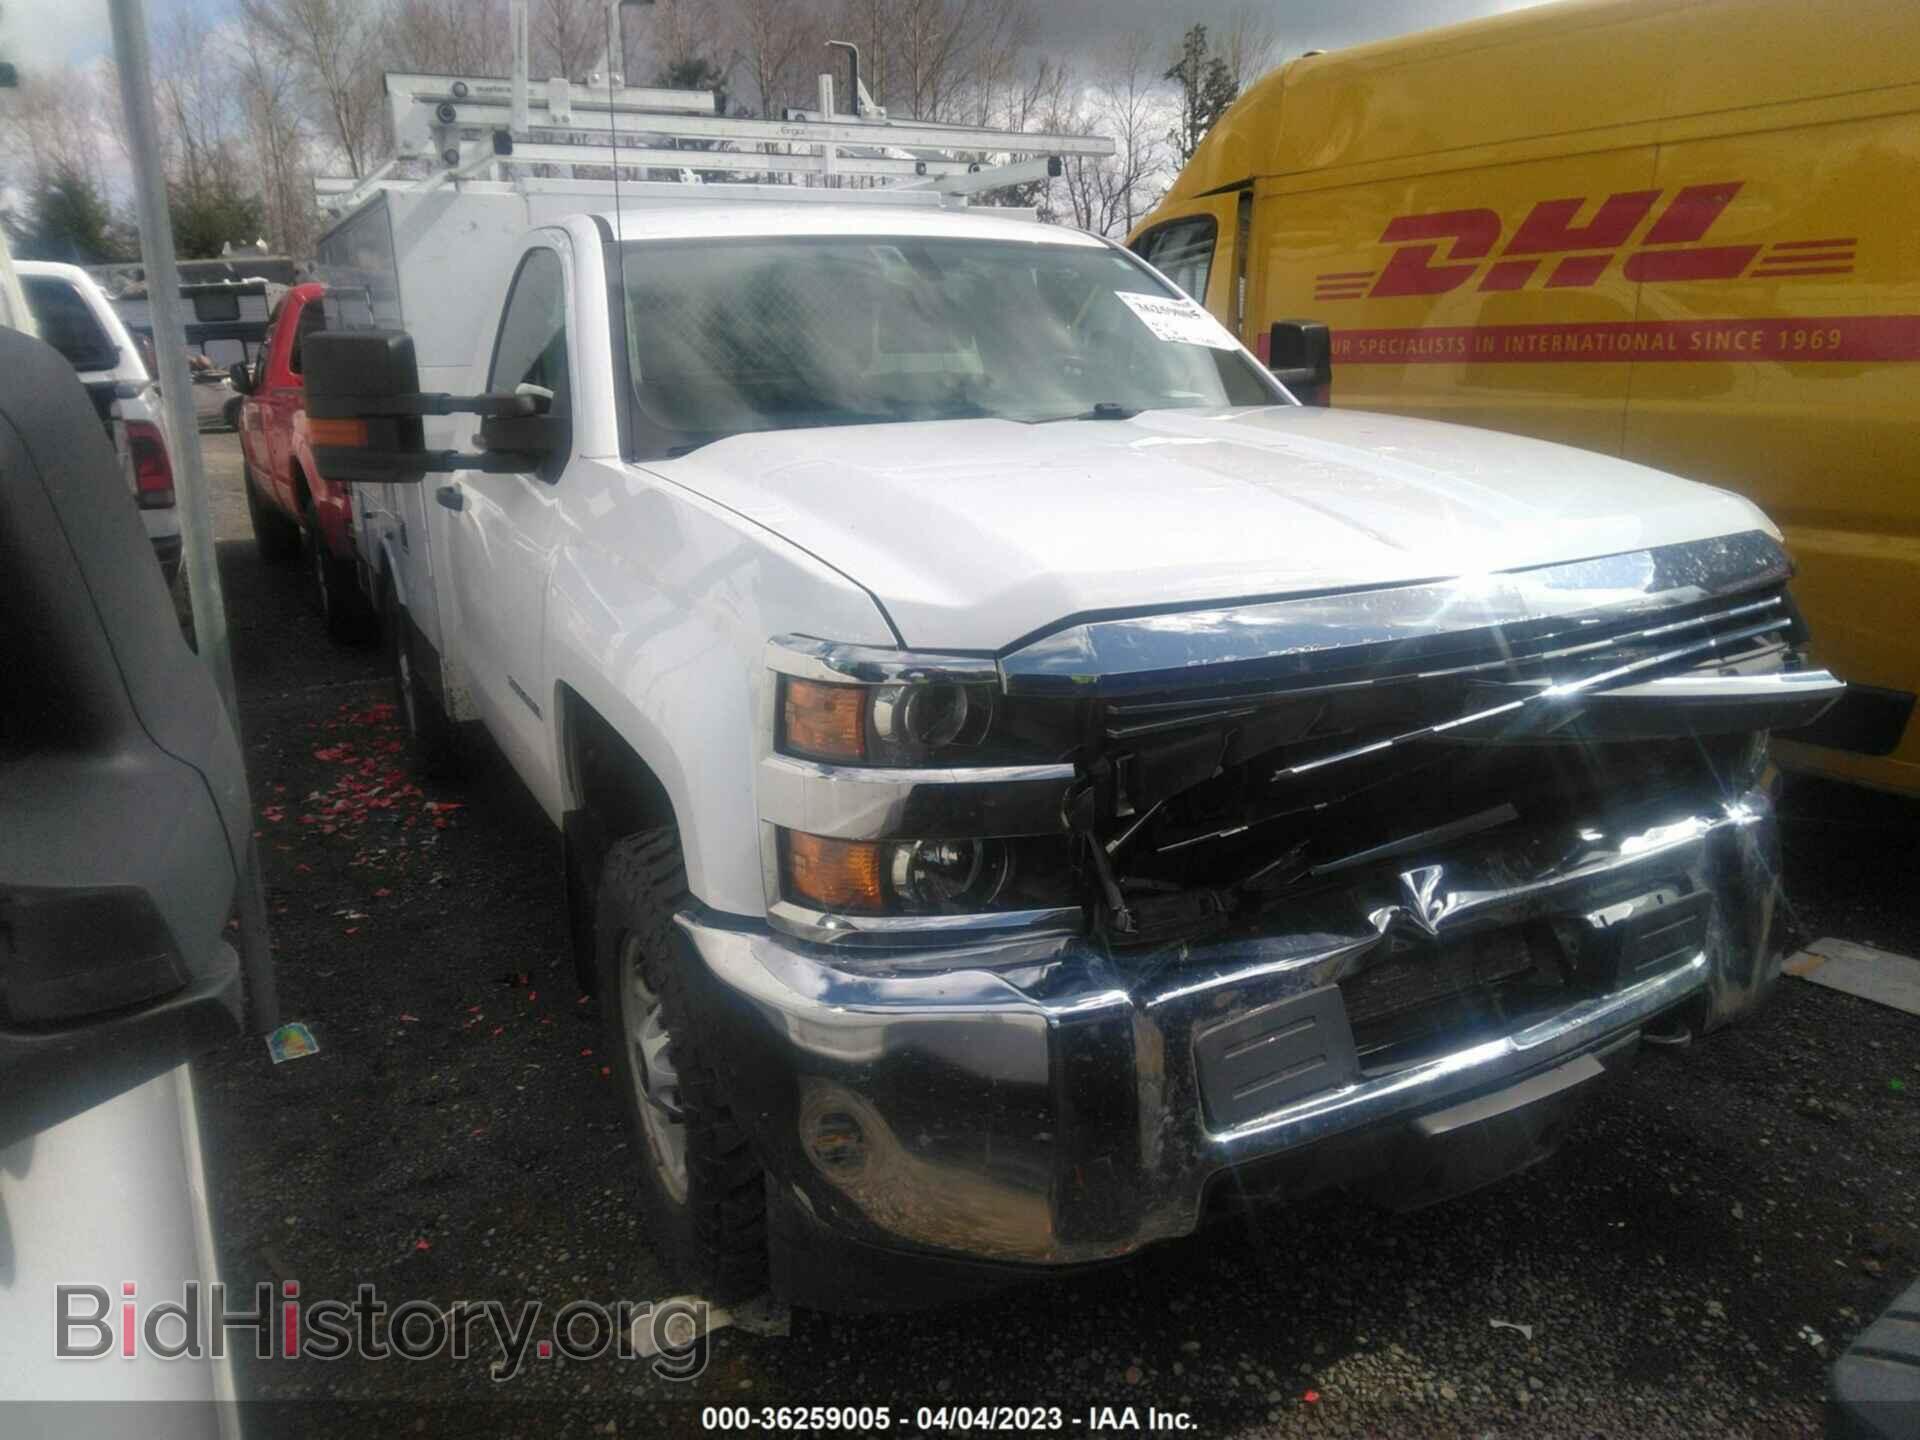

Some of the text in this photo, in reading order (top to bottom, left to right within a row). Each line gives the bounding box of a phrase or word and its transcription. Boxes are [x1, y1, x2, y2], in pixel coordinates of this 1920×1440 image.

[1366, 180, 1765, 298] DHL
[1330, 328, 1842, 355] UR SPECIALISTS IN INTERNATIONAL SINCE 1969
